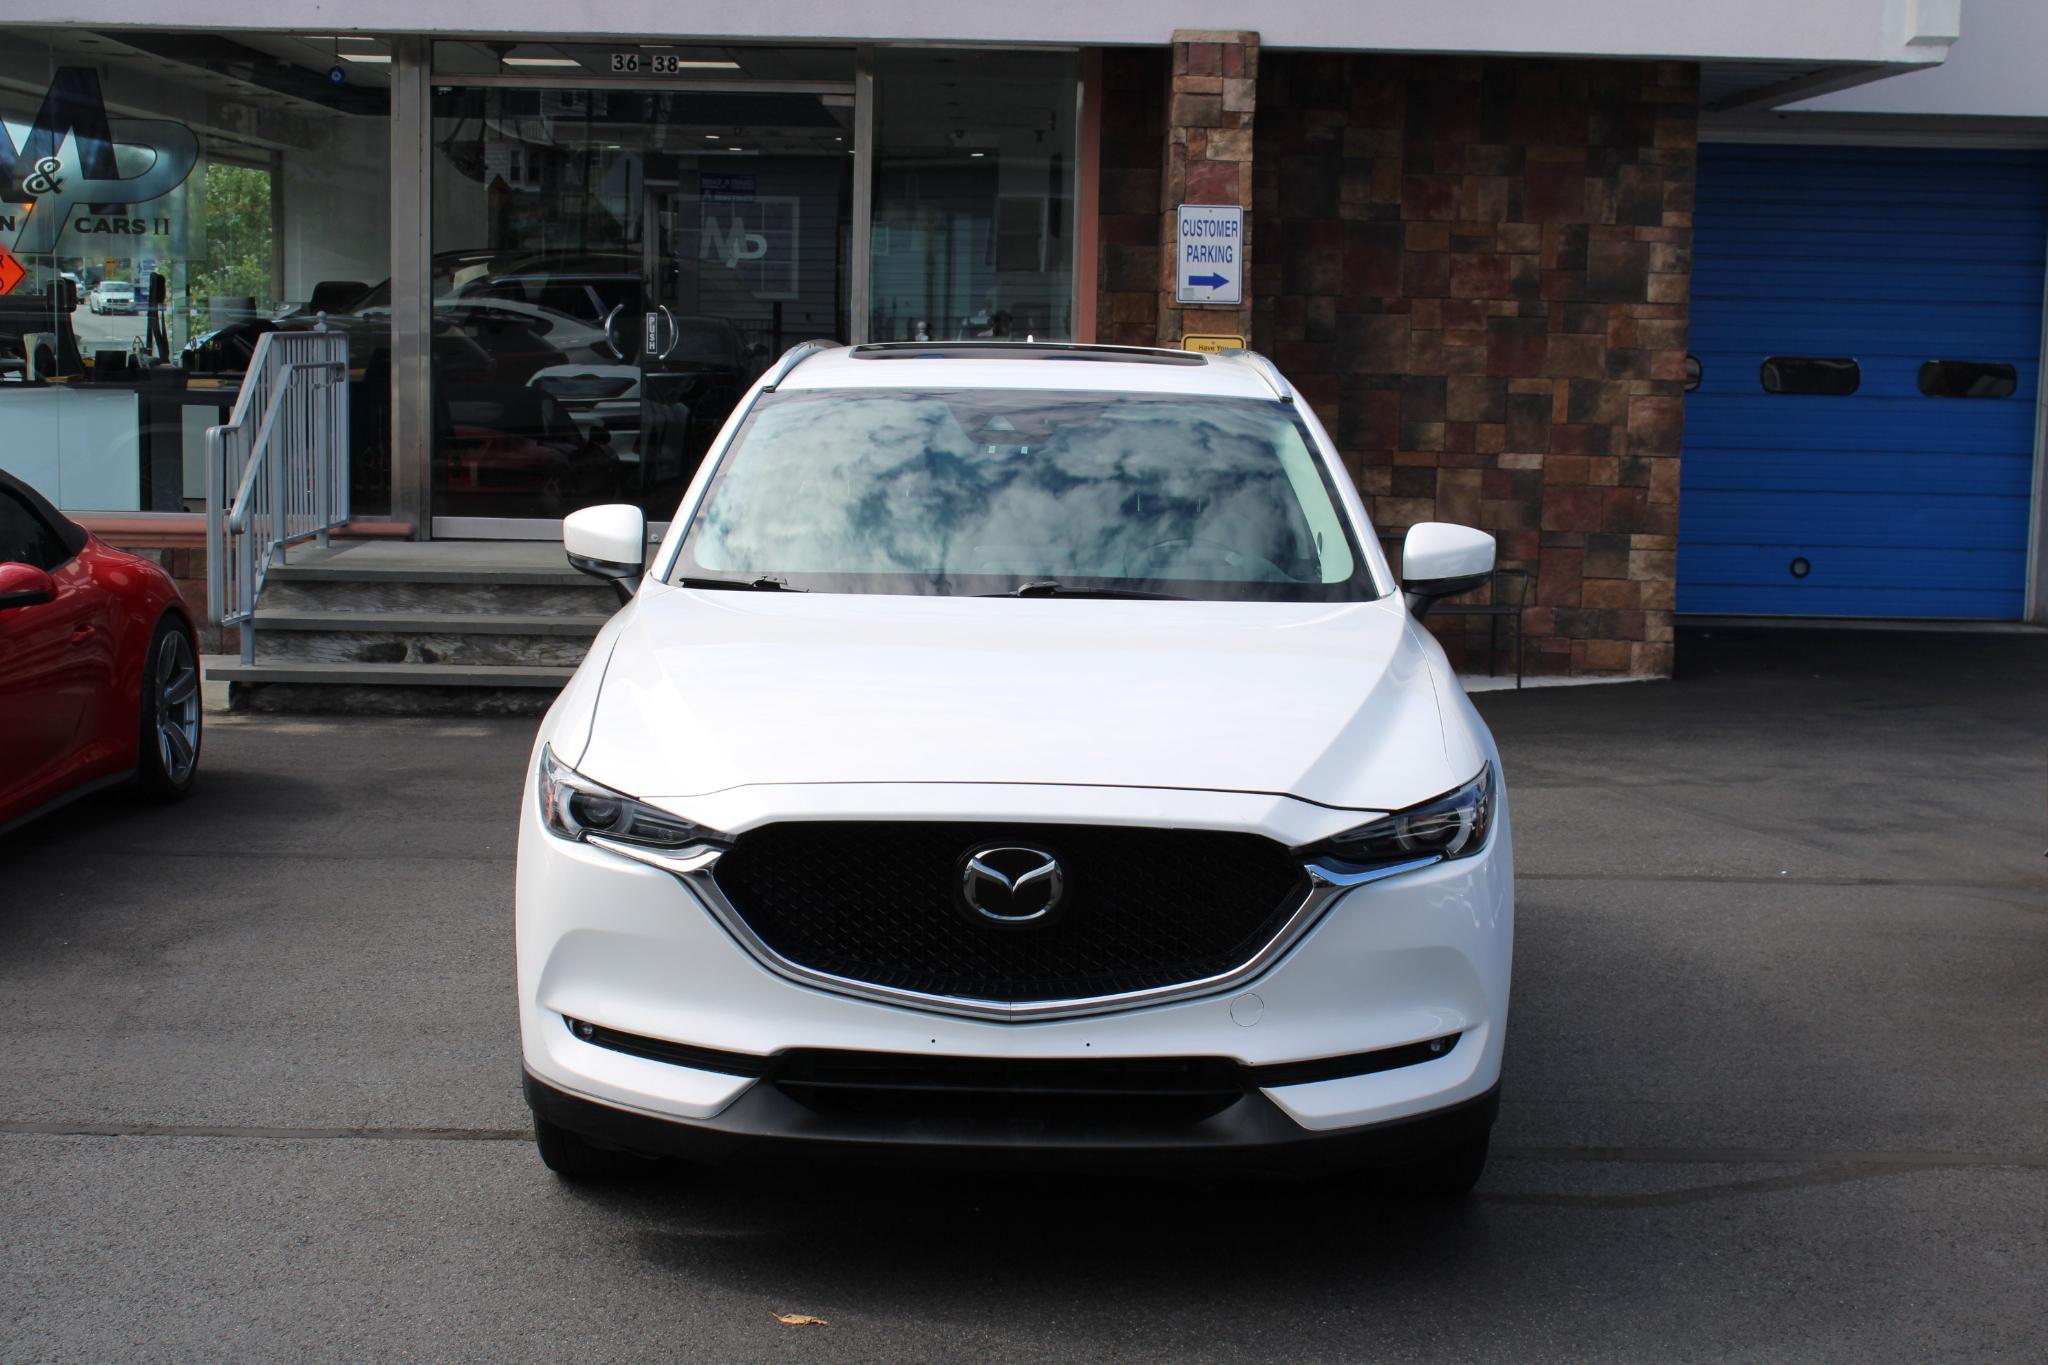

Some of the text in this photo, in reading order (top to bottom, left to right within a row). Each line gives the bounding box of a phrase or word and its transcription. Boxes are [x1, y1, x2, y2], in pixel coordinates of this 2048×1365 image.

[74, 217, 146, 235] CARS
[1182, 219, 1238, 237] CUSTOMER
[1187, 245, 1233, 263] PARKING
